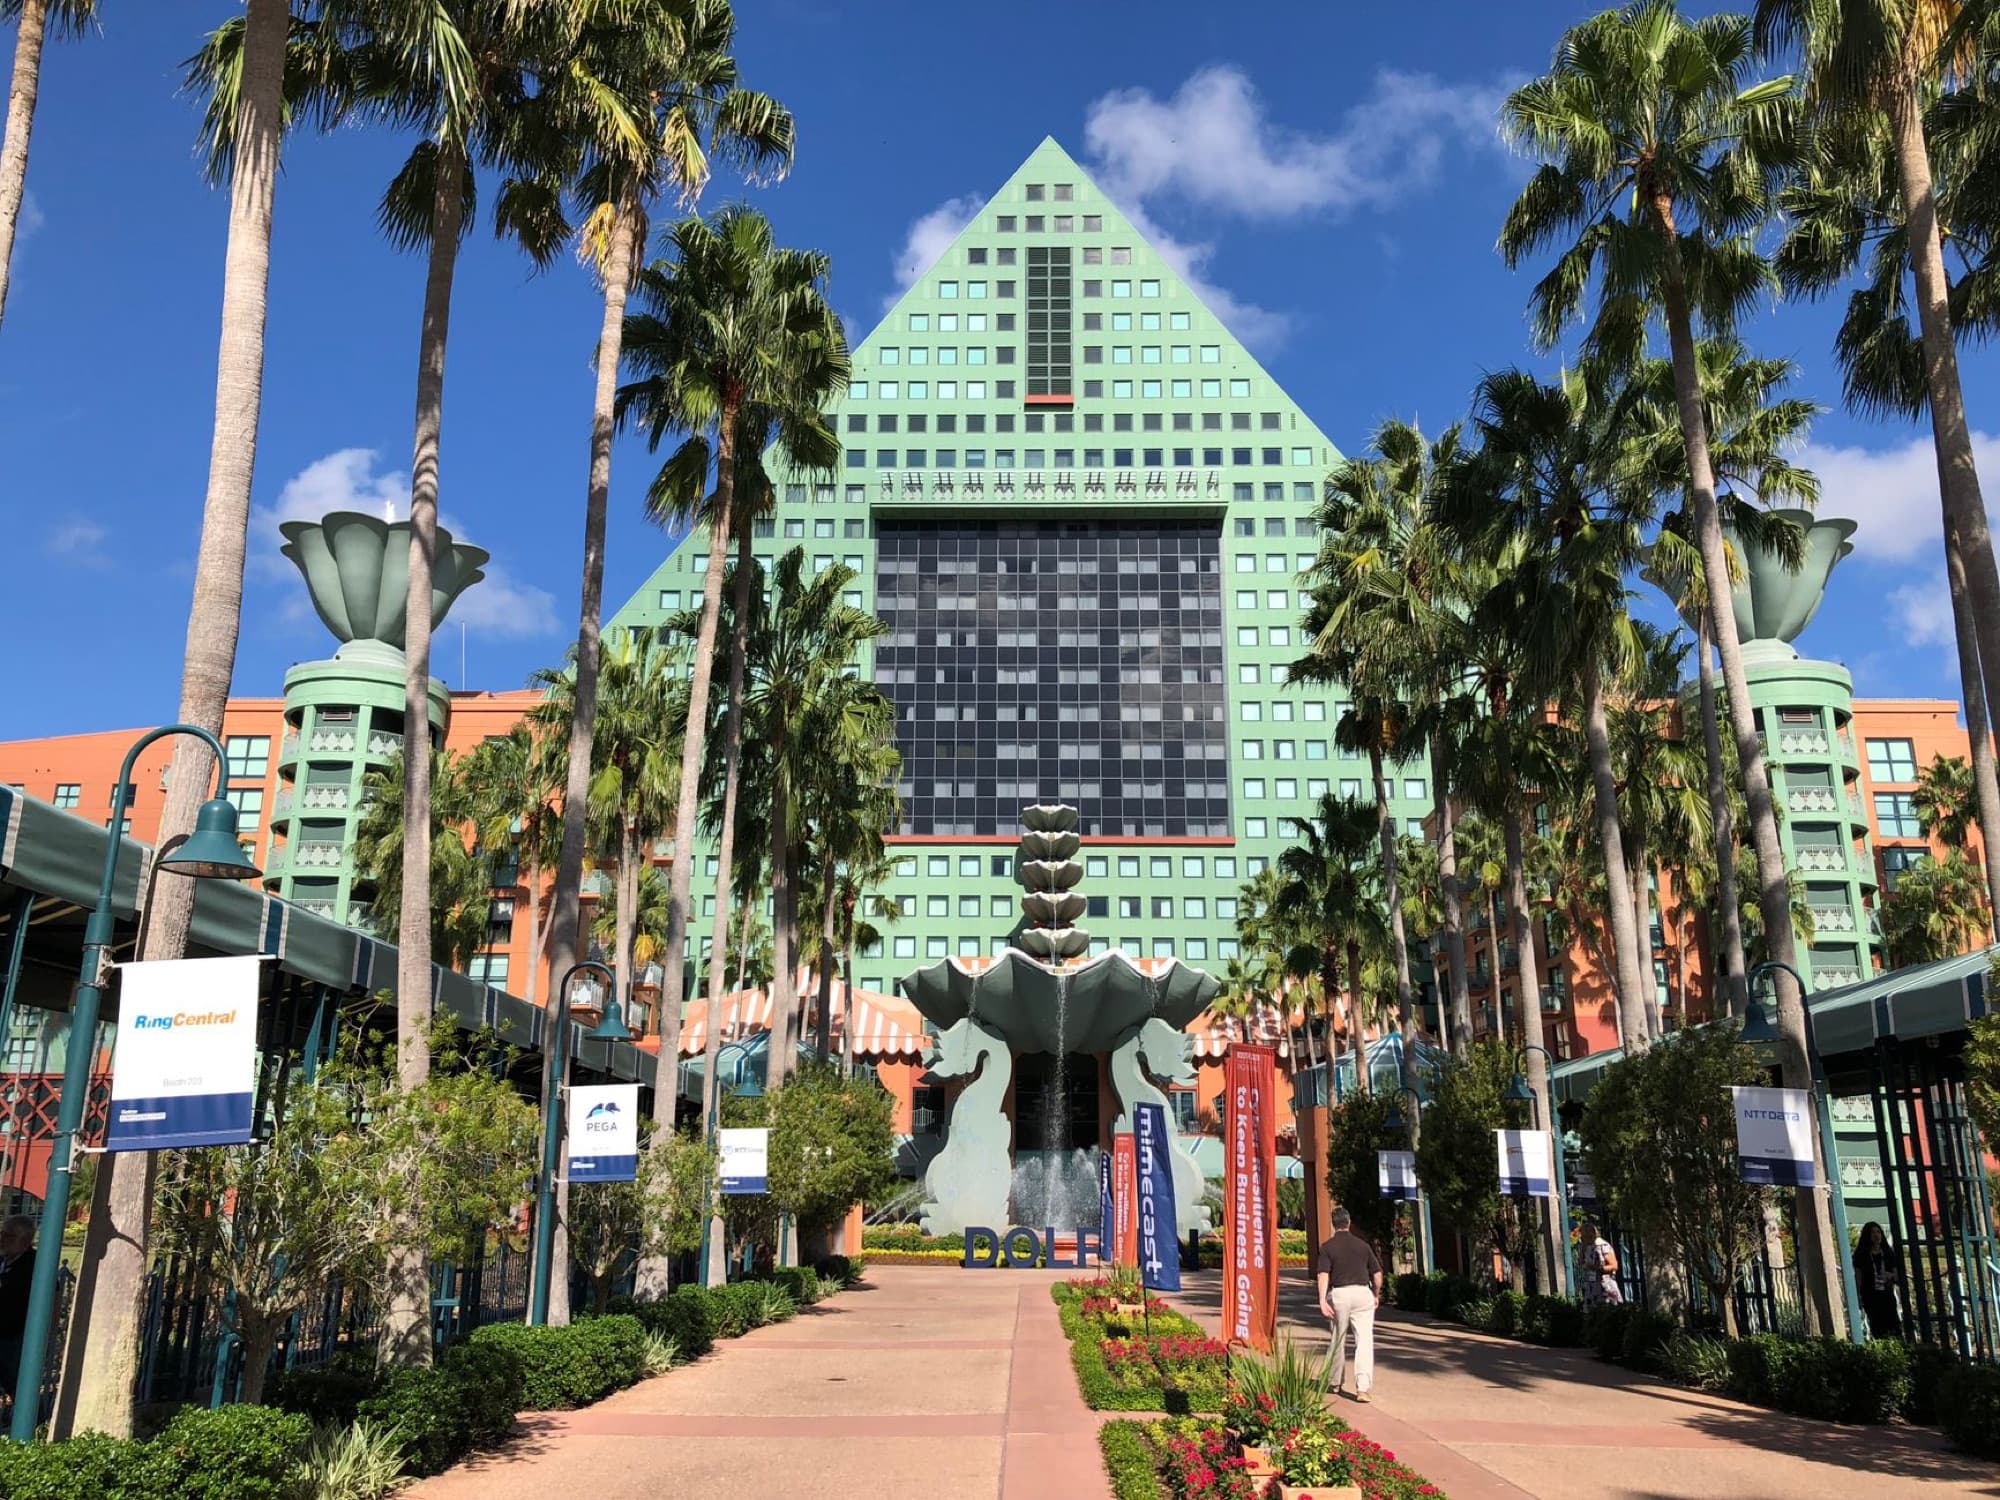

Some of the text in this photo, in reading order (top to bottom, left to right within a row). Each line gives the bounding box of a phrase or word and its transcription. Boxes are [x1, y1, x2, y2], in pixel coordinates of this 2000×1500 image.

[134, 1008, 237, 1030] RingCentral
[1236, 1086, 1247, 1110] to
[586, 1122, 618, 1132] PEGA
[1140, 1107, 1164, 1274] mimecast
[1236, 1173, 1250, 1270] Business
[1235, 1274, 1253, 1340] Going
